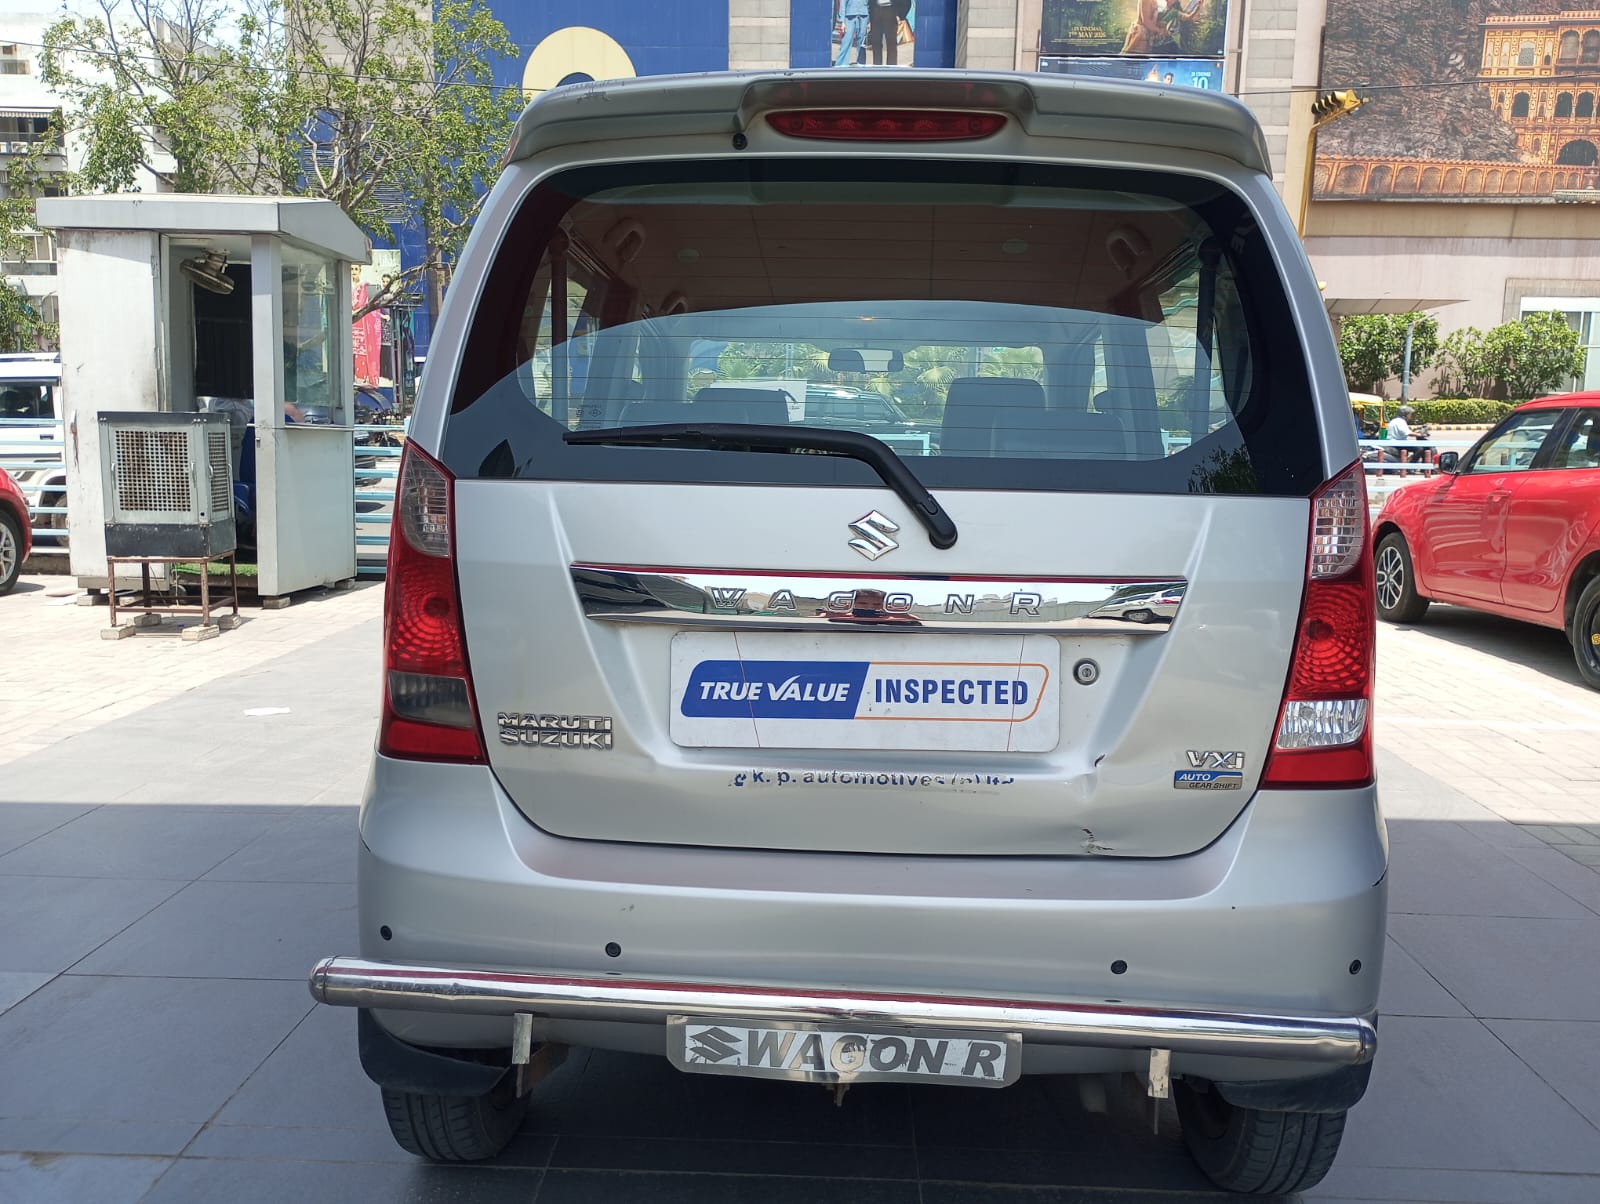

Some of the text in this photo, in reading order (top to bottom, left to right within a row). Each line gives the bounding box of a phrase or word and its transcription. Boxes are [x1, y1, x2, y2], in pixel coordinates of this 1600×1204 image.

[1192, 76, 1209, 89] 10
[699, 674, 1028, 705] TRUE VALUE INSPECTED
[498, 712, 612, 731] MARUTI
[499, 728, 613, 750] SUZUKI
[1186, 750, 1245, 769] VXi
[1178, 773, 1211, 781] AUTO
[748, 1030, 1001, 1079] WAGON R
